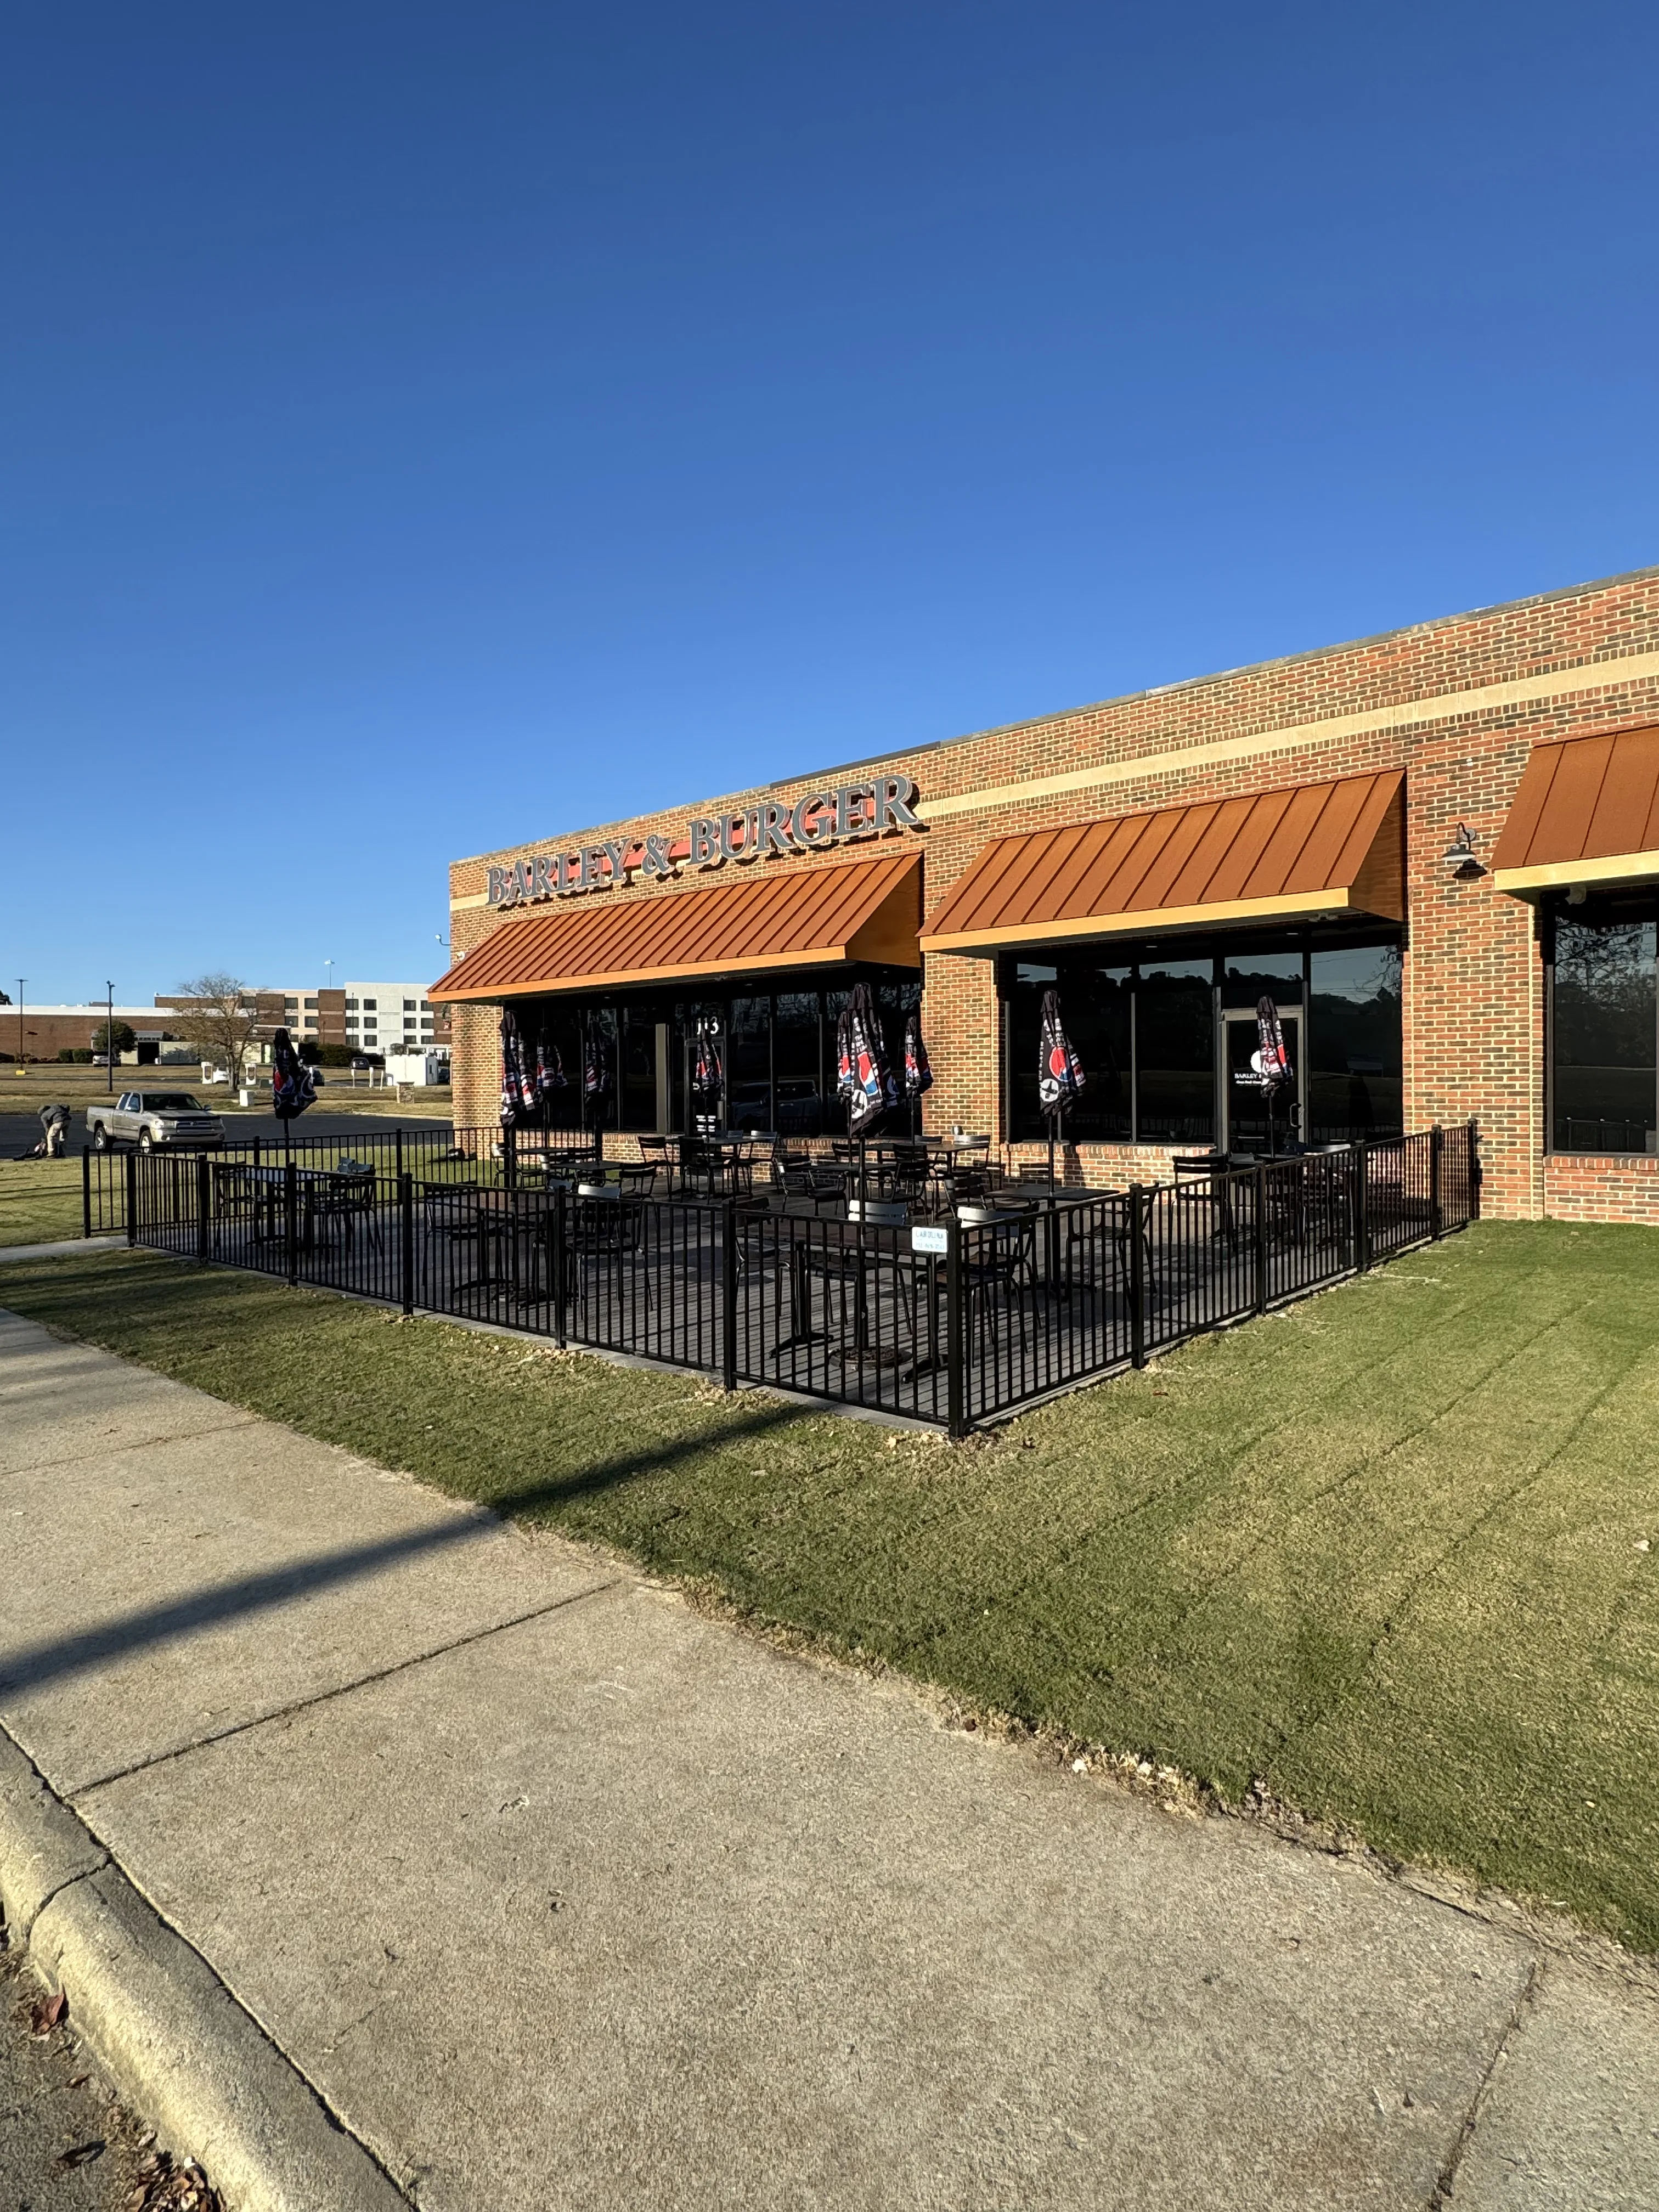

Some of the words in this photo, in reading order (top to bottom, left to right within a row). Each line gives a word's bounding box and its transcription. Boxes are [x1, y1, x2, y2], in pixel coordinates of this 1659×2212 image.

[486, 838, 632, 905] BARLEY
[642, 834, 672, 876] &
[686, 774, 921, 865] BURGER
